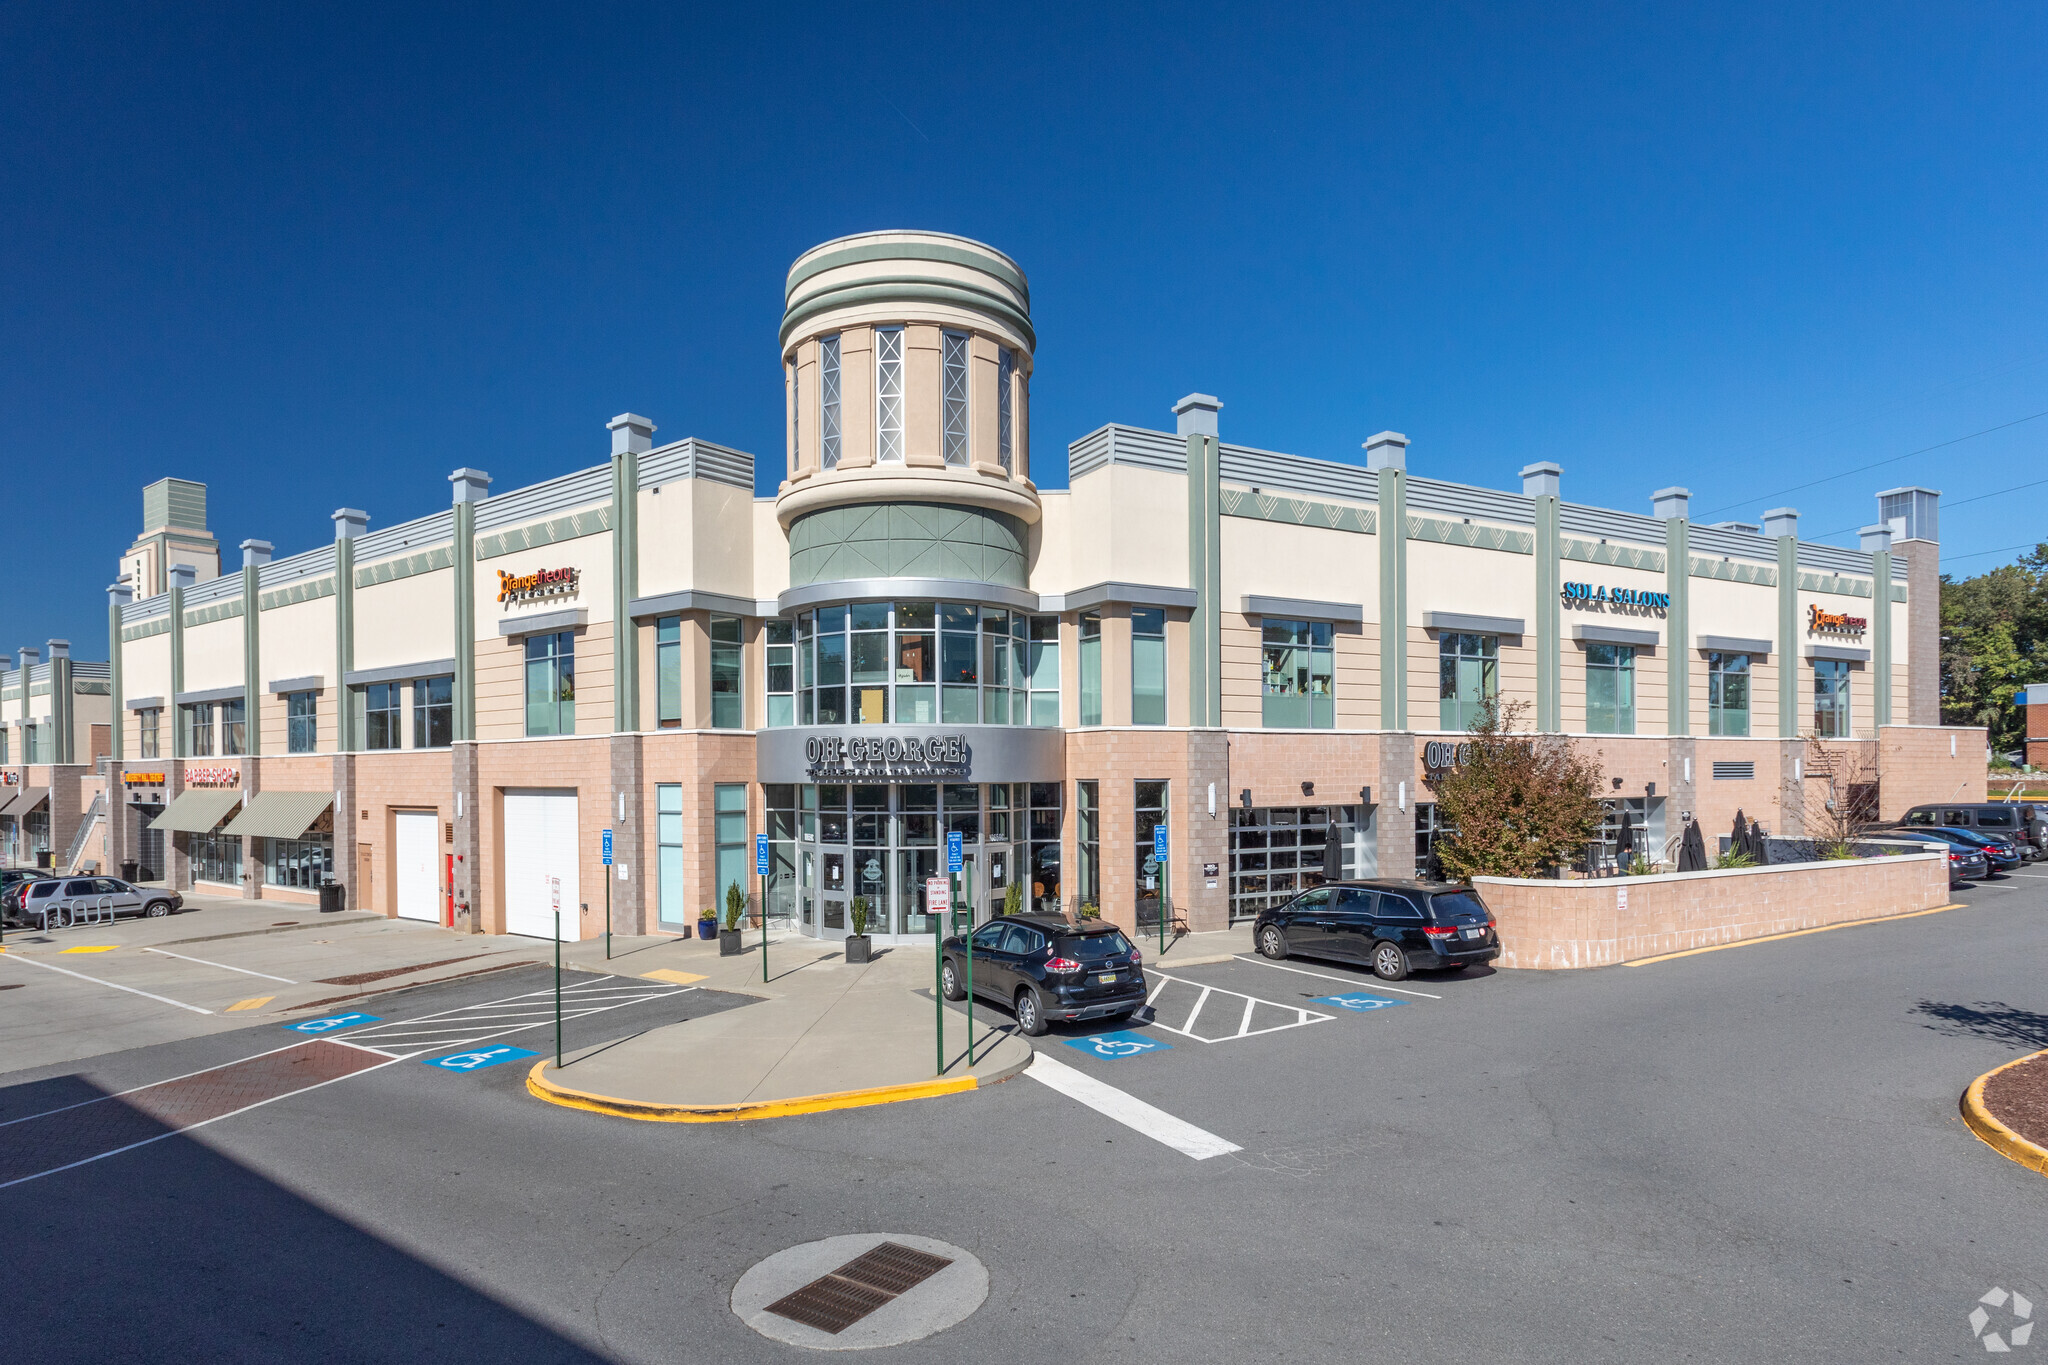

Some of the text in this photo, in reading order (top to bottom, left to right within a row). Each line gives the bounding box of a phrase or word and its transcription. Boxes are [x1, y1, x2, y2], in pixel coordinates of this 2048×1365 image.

[1566, 581, 1671, 608] SOLA SALONS
[805, 733, 968, 764] OH GEORGE!
[1427, 741, 1456, 769] OH
[185, 768, 233, 782] BARBER SHOP
[805, 768, 855, 777] TABLES
[858, 768, 886, 777] AND
